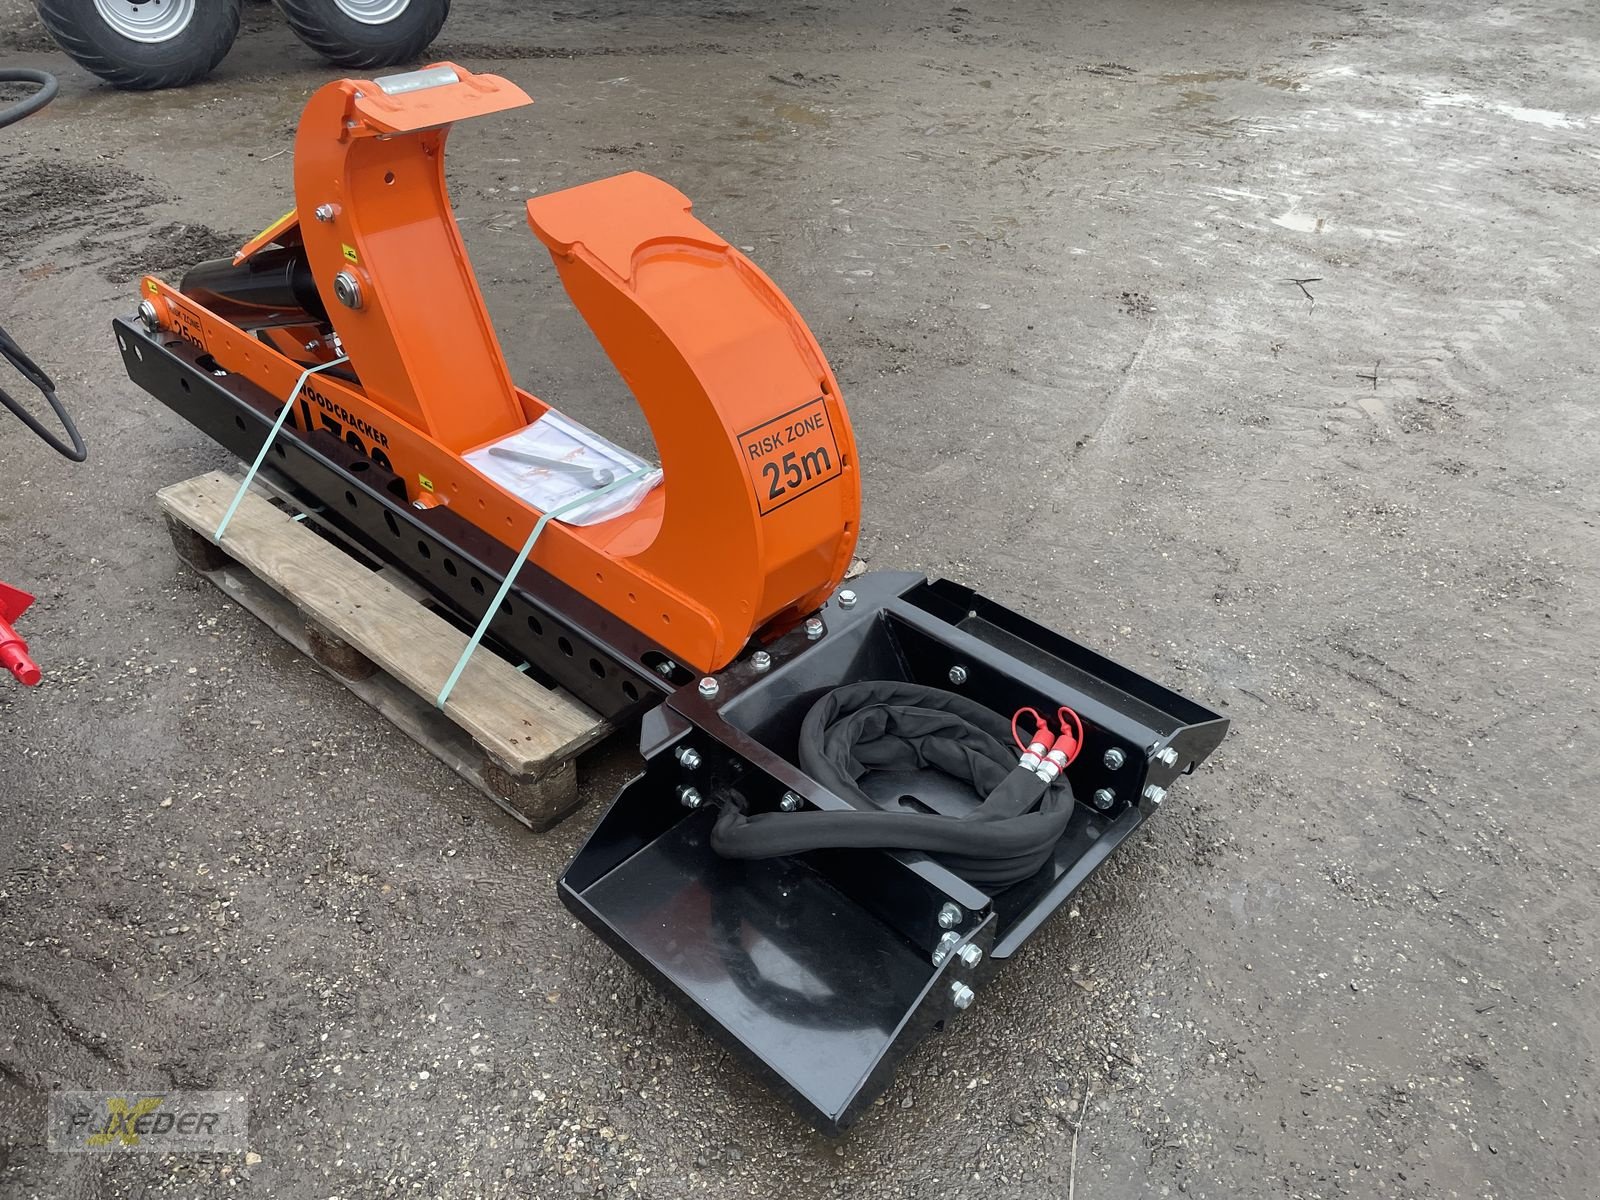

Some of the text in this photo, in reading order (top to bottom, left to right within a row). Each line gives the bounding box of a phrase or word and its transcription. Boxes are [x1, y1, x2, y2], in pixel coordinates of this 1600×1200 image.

[748, 412, 825, 461] RISK ZONE
[762, 446, 832, 501] 25m
